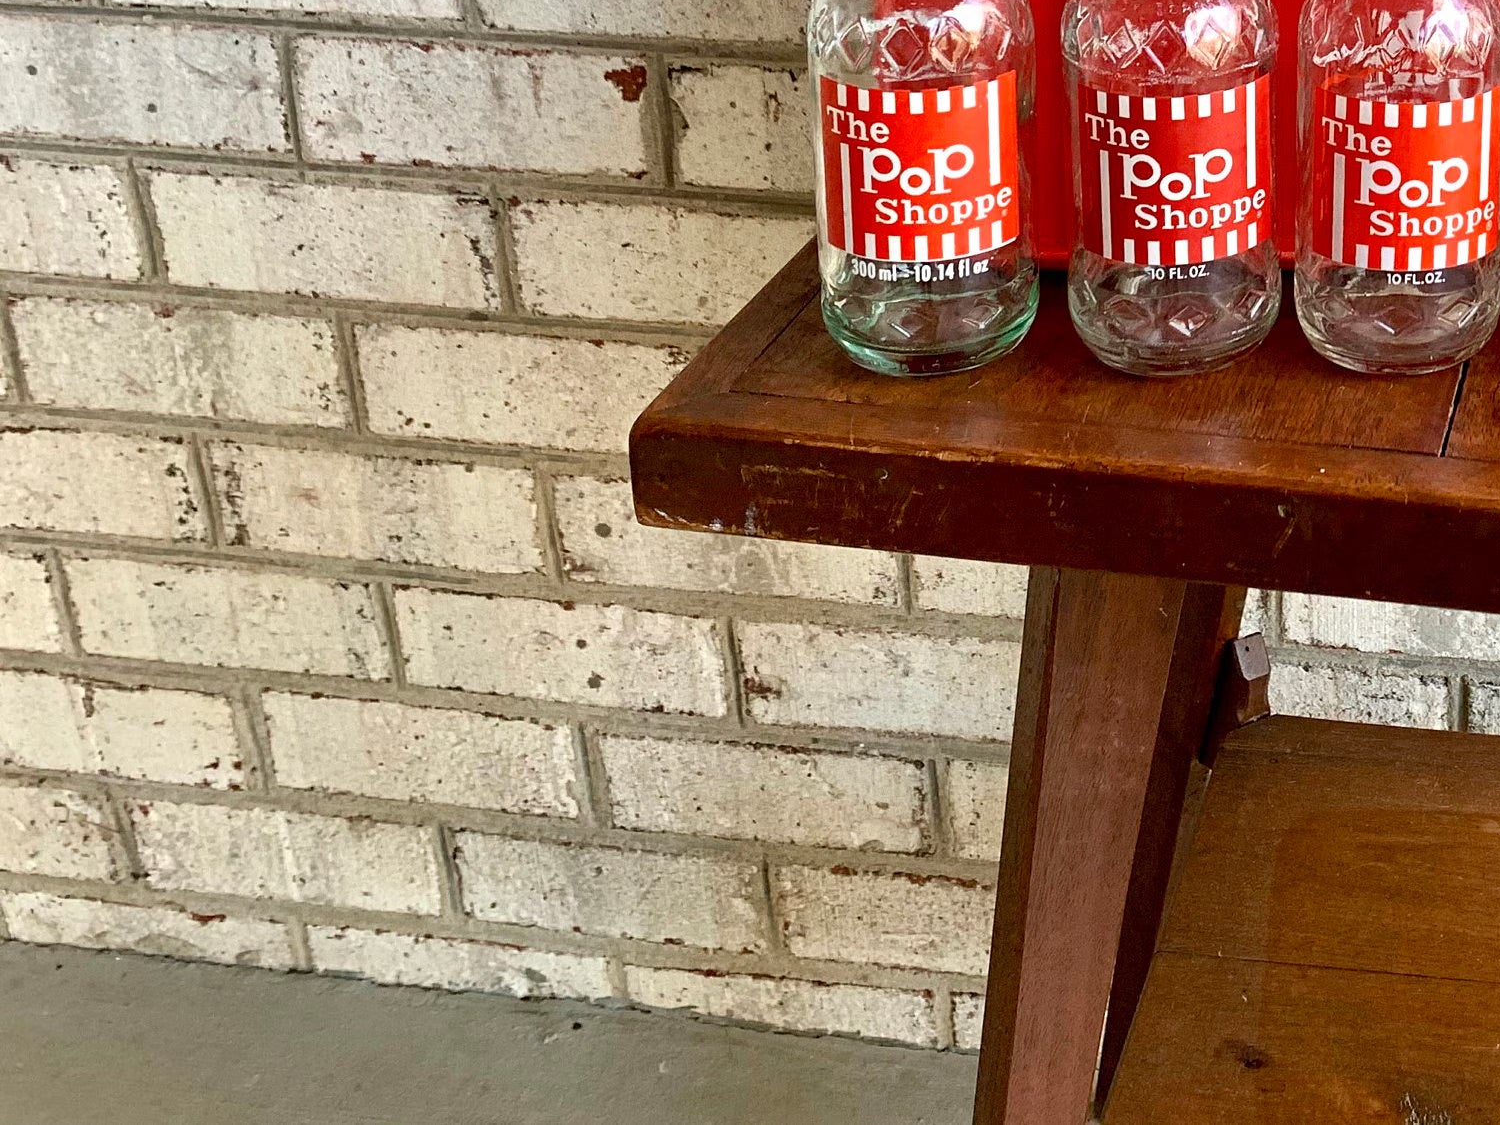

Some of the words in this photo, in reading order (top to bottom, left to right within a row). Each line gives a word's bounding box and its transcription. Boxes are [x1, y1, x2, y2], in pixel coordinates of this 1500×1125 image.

[826, 105, 890, 144] The
[1085, 113, 1150, 149] The
[1321, 116, 1392, 156] The
[875, 186, 1012, 226] Shoppe
[1134, 188, 1266, 230] Shoppe
[1369, 199, 1495, 238] Shoppe
[850, 258, 876, 280] 300
[958, 258, 971, 279] fl
[973, 258, 989, 275] oz
[1151, 268, 1165, 280] 10
[1386, 273, 1402, 285] 10
